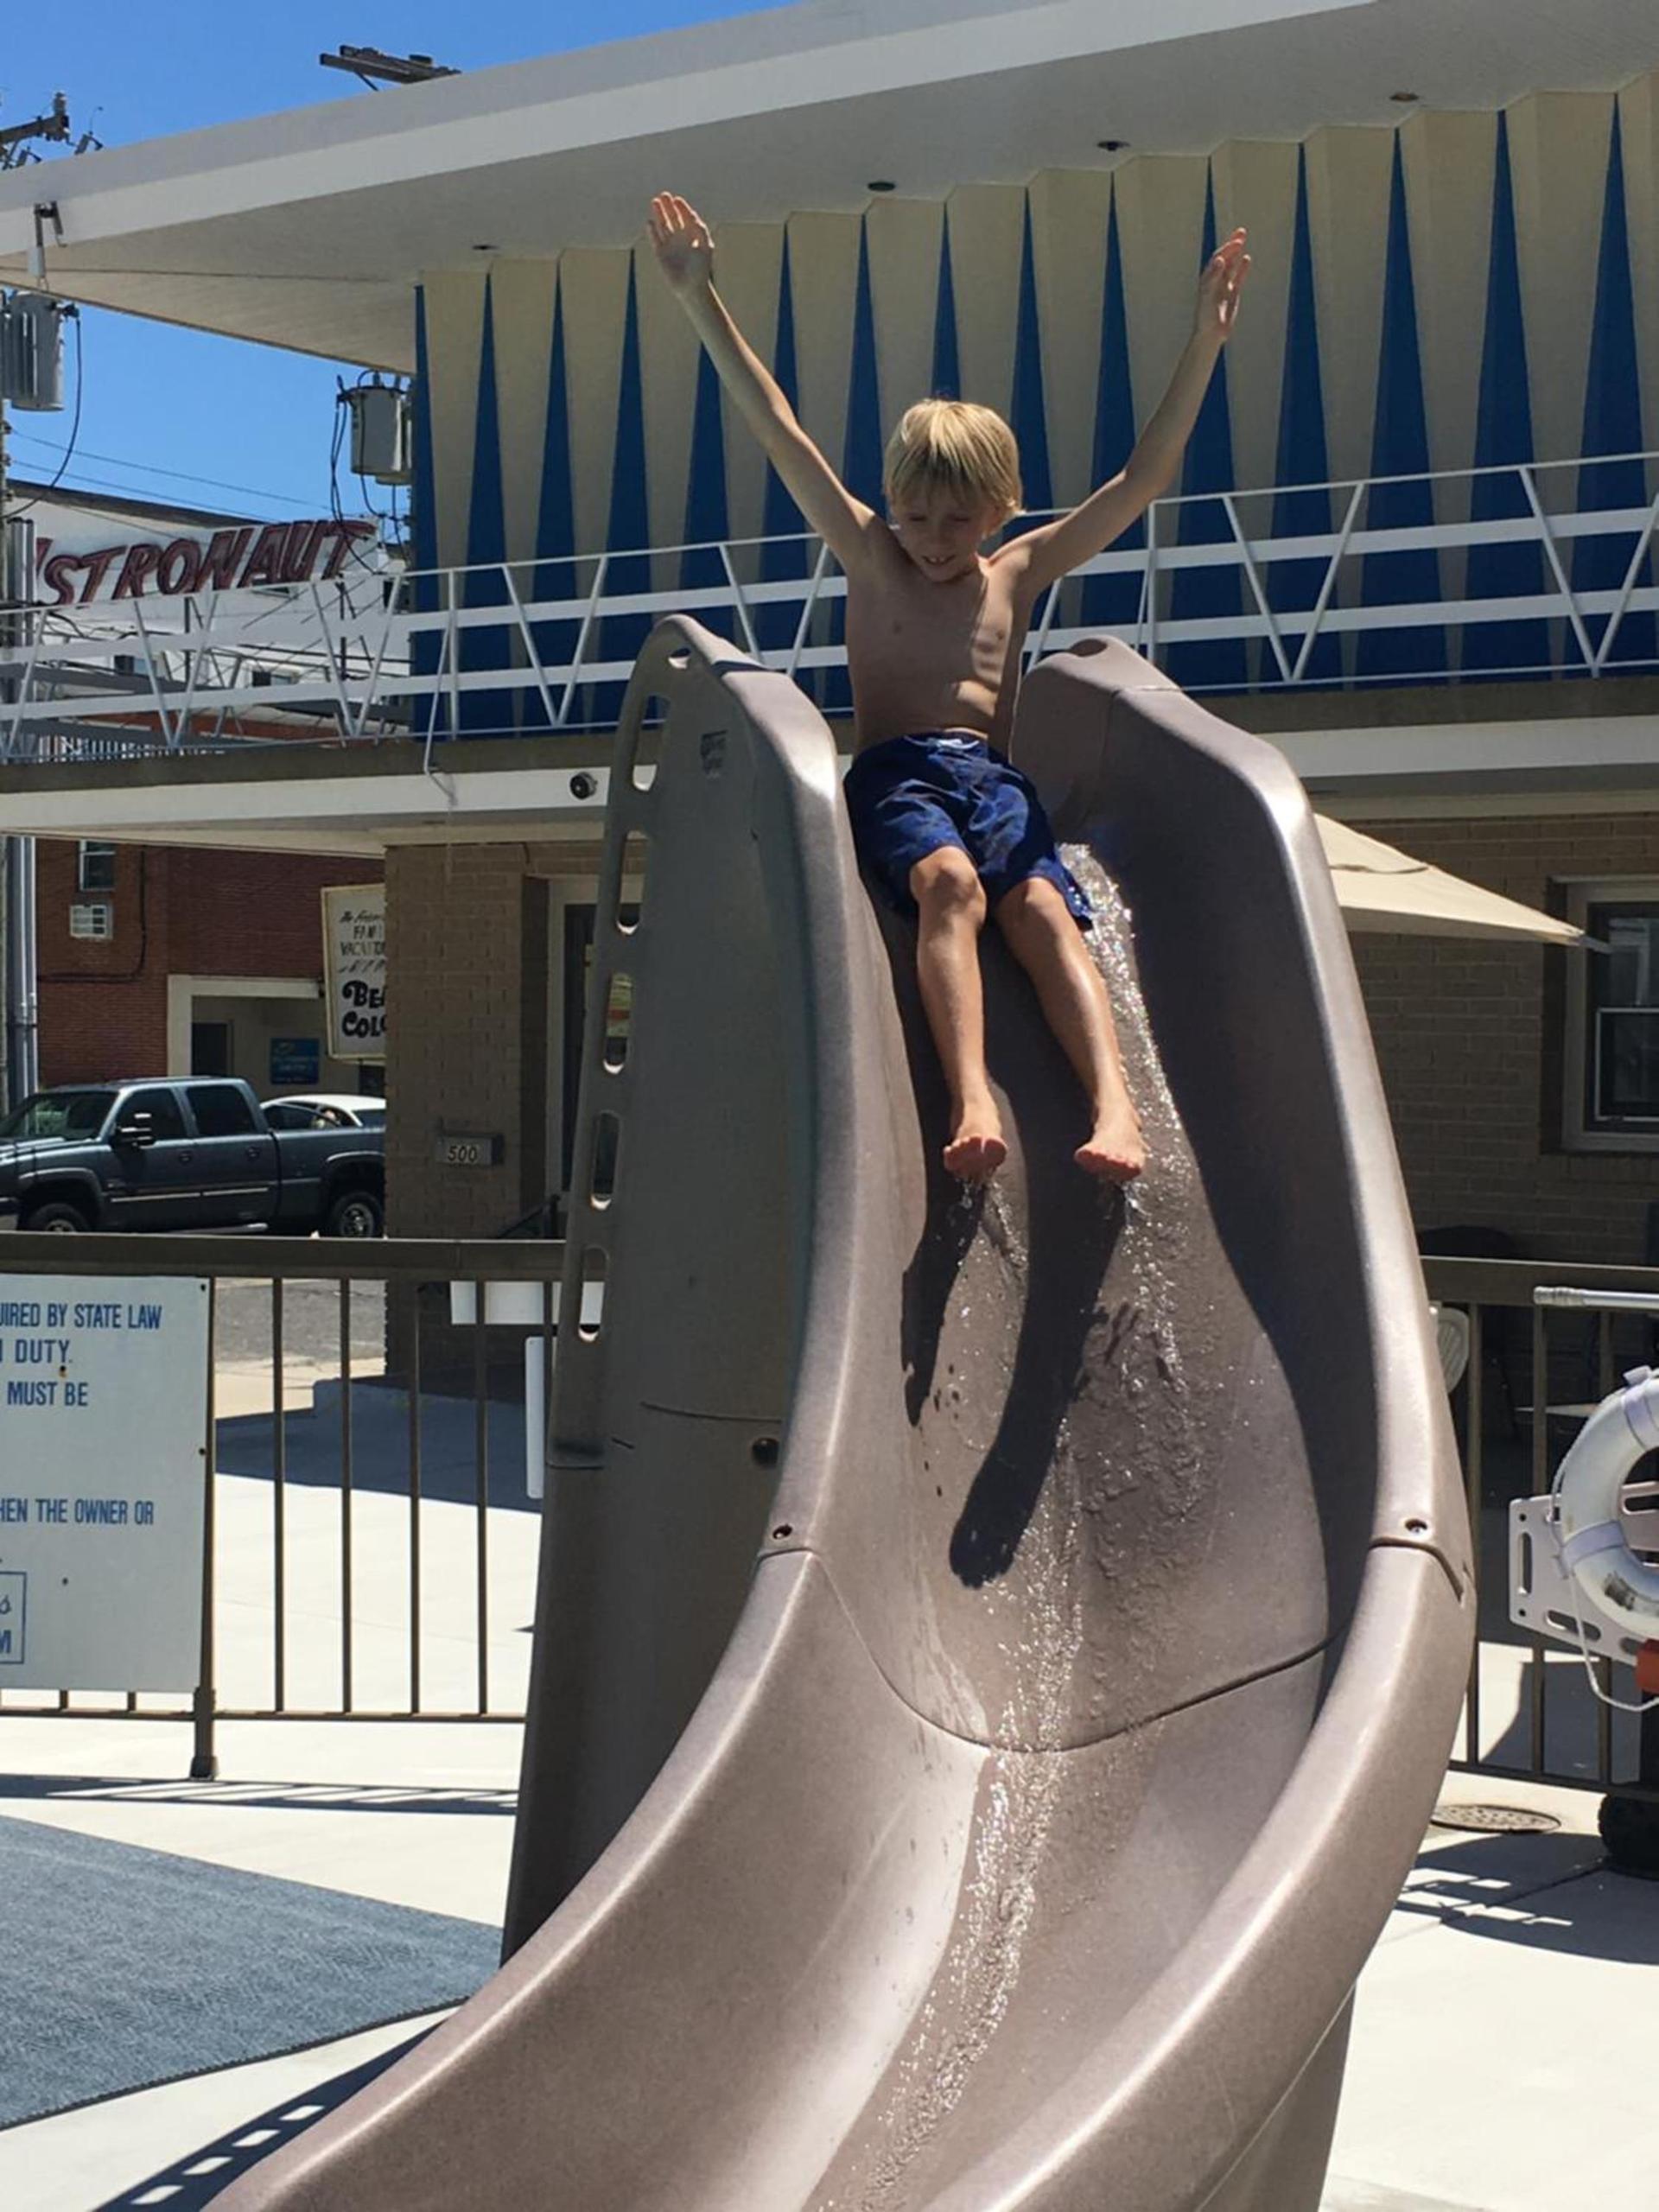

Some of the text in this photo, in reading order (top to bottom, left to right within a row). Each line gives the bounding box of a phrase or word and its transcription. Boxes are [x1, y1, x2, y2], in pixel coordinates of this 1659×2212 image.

[35, 520, 378, 608] STRONAUT
[448, 1146, 478, 1162] 500
[48, 1303, 67, 1327] BY
[74, 1304, 122, 1328] STATE
[129, 1305, 162, 1329] LAW
[8, 1382, 88, 1407] MUST BE
[35, 1498, 67, 1523] THE
[74, 1499, 128, 1523] OWNER
[135, 1501, 154, 1525] OR
